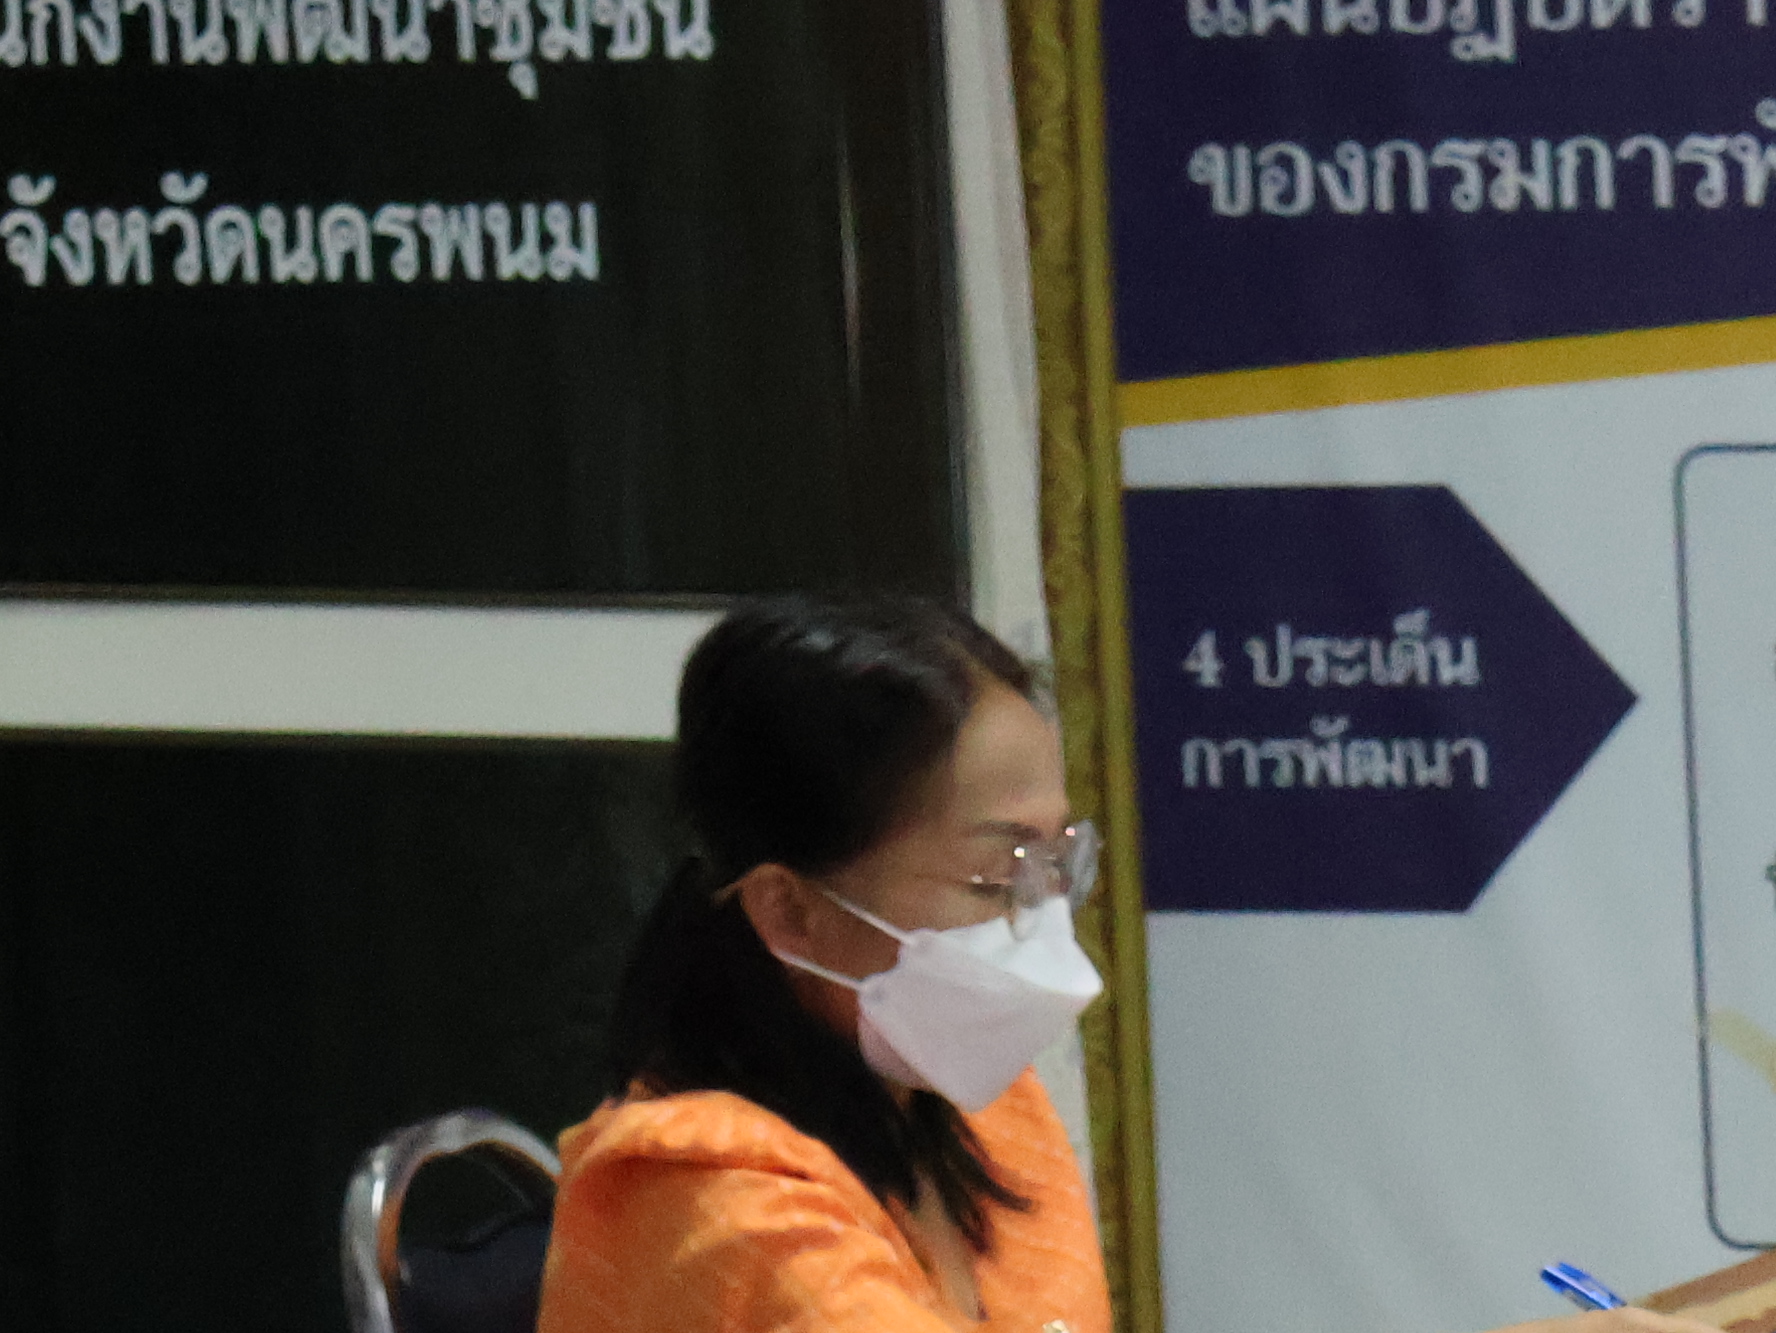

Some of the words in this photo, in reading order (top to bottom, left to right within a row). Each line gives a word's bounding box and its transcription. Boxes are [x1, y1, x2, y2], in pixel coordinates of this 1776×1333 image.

[1, 172, 599, 287] จังหวัดนครพนม
[1183, 631, 1224, 687] 4
[1246, 608, 1481, 688] ประเด็น
[1182, 716, 1490, 789] การพัฒนา
